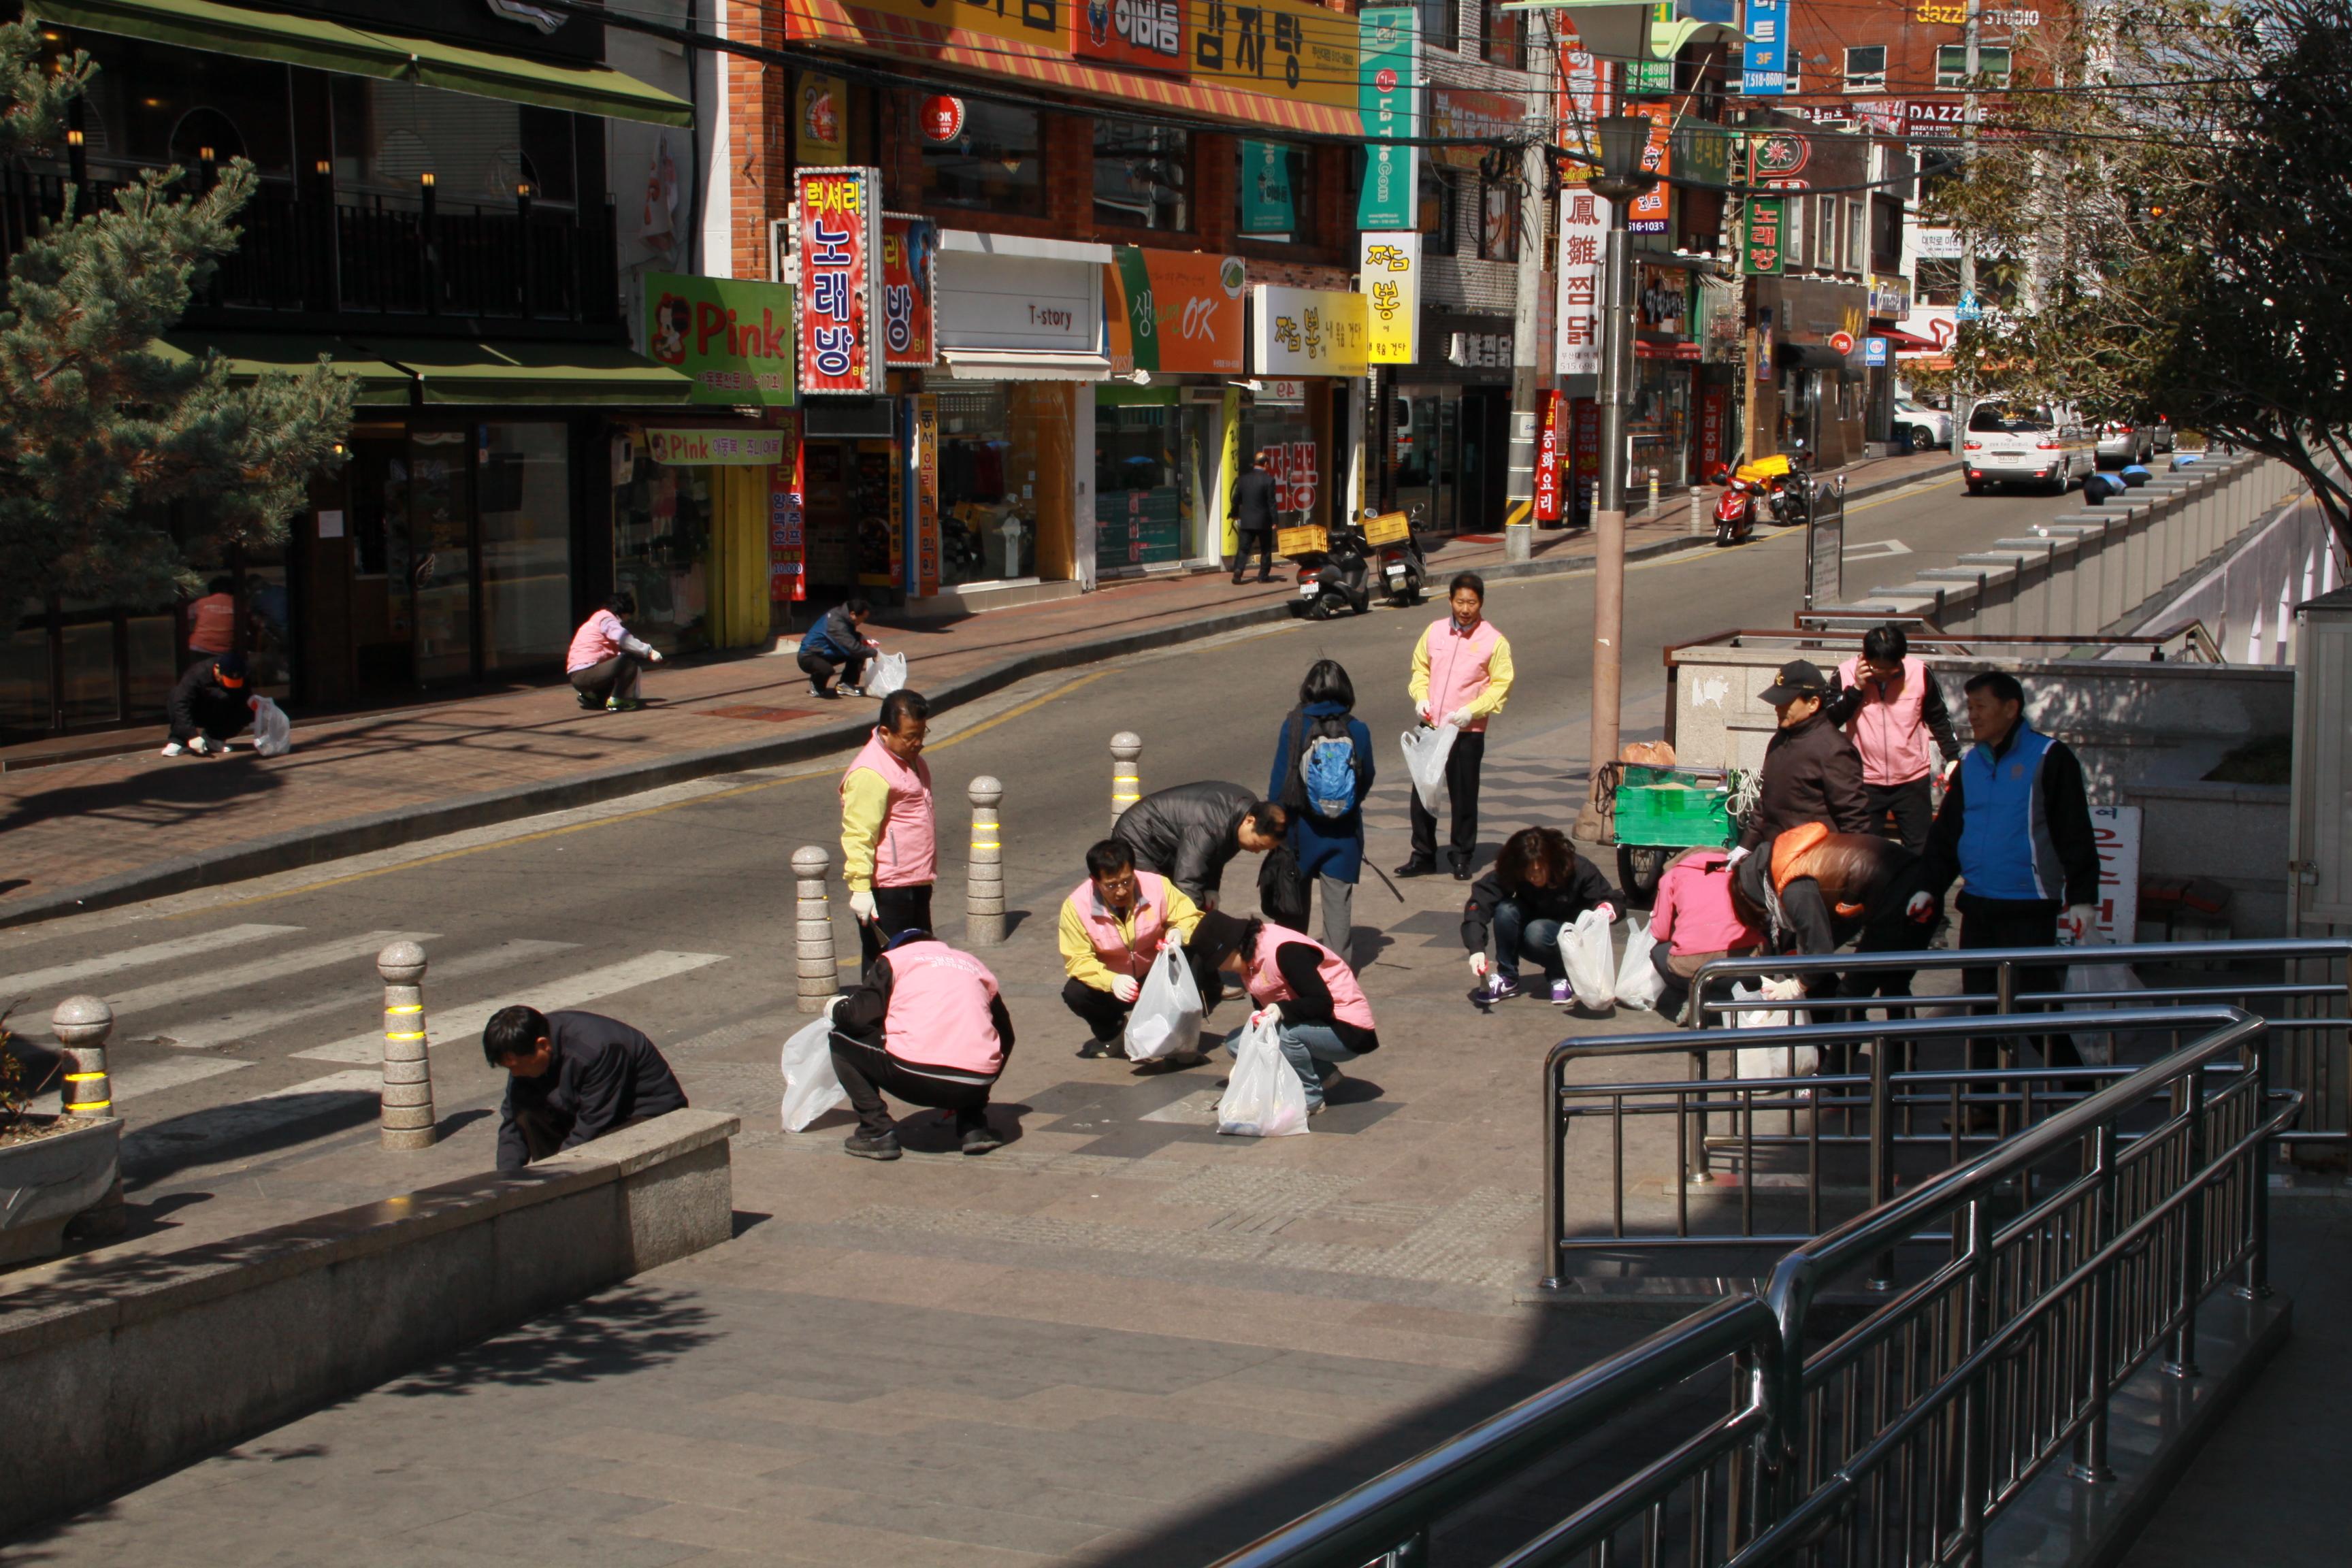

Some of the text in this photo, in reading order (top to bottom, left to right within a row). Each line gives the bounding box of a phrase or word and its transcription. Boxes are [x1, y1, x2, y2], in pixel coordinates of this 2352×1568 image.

[1984, 10, 2039, 26] STUDIO
[1756, 52, 1773, 65] 3F
[1745, 72, 1782, 88] T.518-8600
[936, 112, 951, 122] OK
[1379, 99, 1392, 122] LG
[1910, 105, 1988, 122] DAZZE
[1378, 127, 1393, 203] TleCom
[806, 181, 860, 215] 럭셔리
[1750, 204, 1778, 270] 노래방
[812, 218, 855, 376] 노래방
[1028, 304, 1073, 331] T-story
[1183, 296, 1220, 343] OK
[696, 301, 785, 359] Pink
[1326, 321, 1334, 339] 내
[1336, 322, 1345, 348] 목숨
[1348, 321, 1362, 348] 건다
[914, 339, 925, 353] B1
[1377, 342, 1406, 356] 목숨 건다
[852, 366, 865, 376] B1
[1560, 362, 1596, 371] 515.698
[1704, 399, 1716, 462] 노래주점
[669, 434, 708, 460] Pink
[713, 437, 780, 457] 아동복 주니어복
[1540, 430, 1556, 514] 중화요리
[773, 493, 802, 510] 양주
[773, 512, 802, 527] 맥주
[773, 530, 802, 545] 호프
